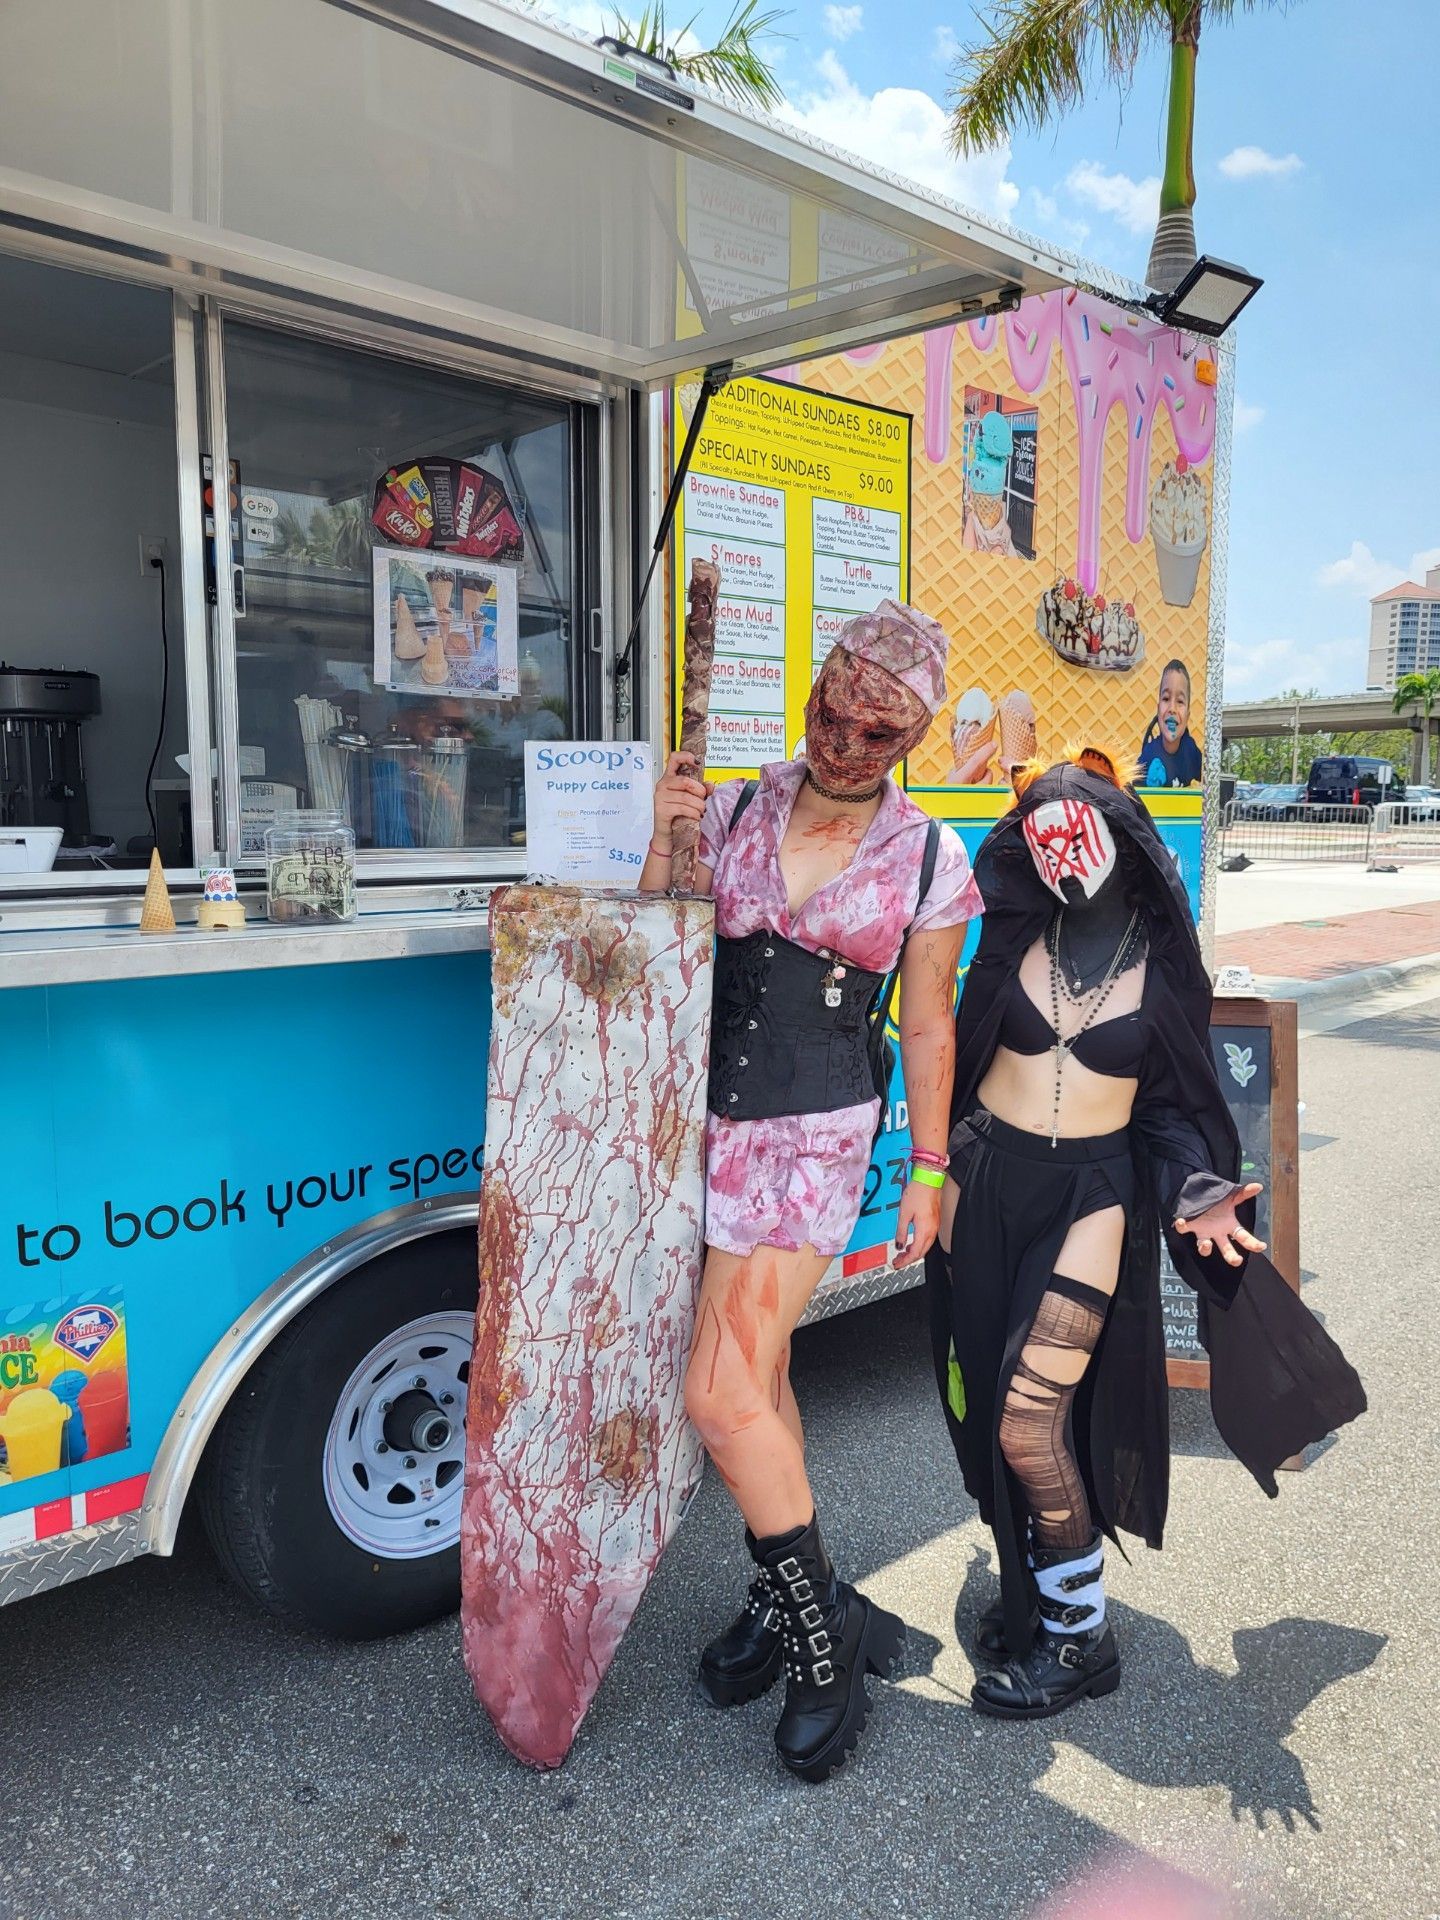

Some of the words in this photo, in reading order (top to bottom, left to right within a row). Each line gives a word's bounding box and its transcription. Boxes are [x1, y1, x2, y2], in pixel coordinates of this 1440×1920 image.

[711, 410, 746, 429] Toppings:
[720, 383, 799, 417] ADITIONAL
[802, 402, 860, 431] SUNDAES
[867, 418, 901, 441] $8.00
[699, 437, 768, 468] SPECIALTY
[770, 453, 831, 482] SUNDAES
[859, 471, 893, 494] $9.00
[690, 476, 736, 500] Brownie
[739, 486, 779, 507] Sundae
[257, 502, 273, 515] Pay
[257, 528, 271, 539] Pay
[711, 543, 762, 568] S'mores
[843, 561, 872, 580] Turtle
[714, 601, 741, 620] ocha
[745, 603, 773, 622] Mud
[815, 614, 844, 632] Cooki
[712, 664, 735, 676] ana
[738, 660, 781, 679] Sundae
[715, 715, 750, 734] Peanut
[753, 717, 784, 735] Butter
[536, 747, 645, 771] Scoop's
[547, 780, 587, 793] Puppy
[591, 780, 630, 790] Cakes
[295, 846, 344, 866] TIPS
[608, 848, 642, 866] $3.50
[16, 1222, 82, 1267] to
[104, 1178, 247, 1249] book
[265, 1162, 373, 1228] your
[62, 1321, 110, 1342] Phillies
[0, 1353, 39, 1390] CE
